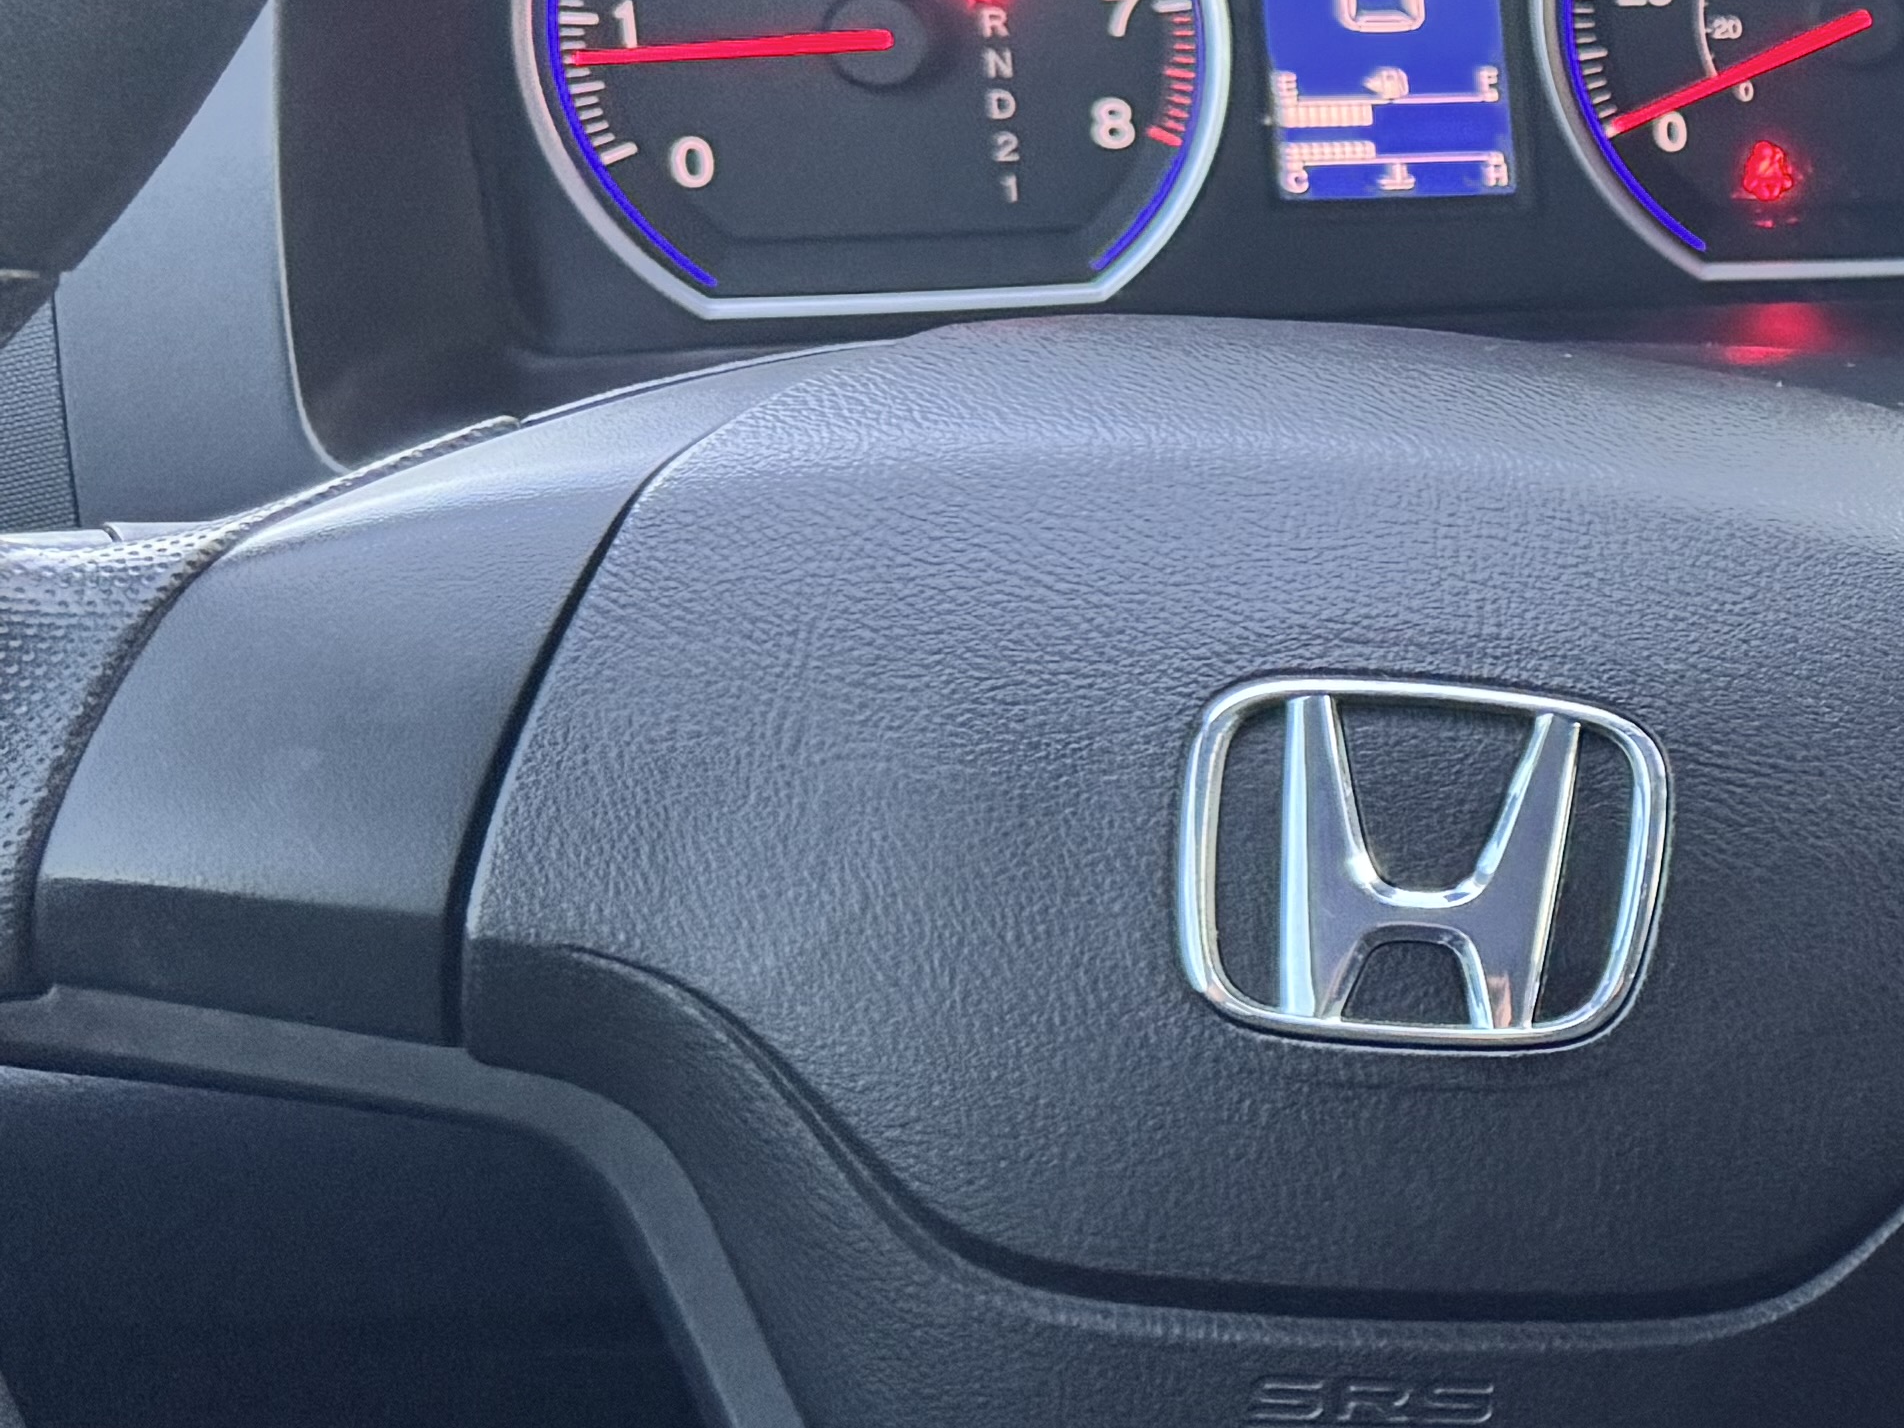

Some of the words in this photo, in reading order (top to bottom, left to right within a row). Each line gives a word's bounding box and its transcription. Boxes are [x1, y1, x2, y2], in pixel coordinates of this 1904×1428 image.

[614, 0, 638, 47] 1
[980, 6, 1010, 37] R
[1711, 16, 1743, 40] 20
[985, 47, 1014, 78] N
[987, 88, 1017, 119] D
[1735, 81, 1754, 103] 0
[1090, 97, 1136, 149] 8
[1654, 112, 1687, 152] 0
[993, 130, 1020, 161] 2
[671, 137, 714, 187] 0
[1001, 174, 1018, 202] 1
[1250, 1378, 1495, 1424] SRS
